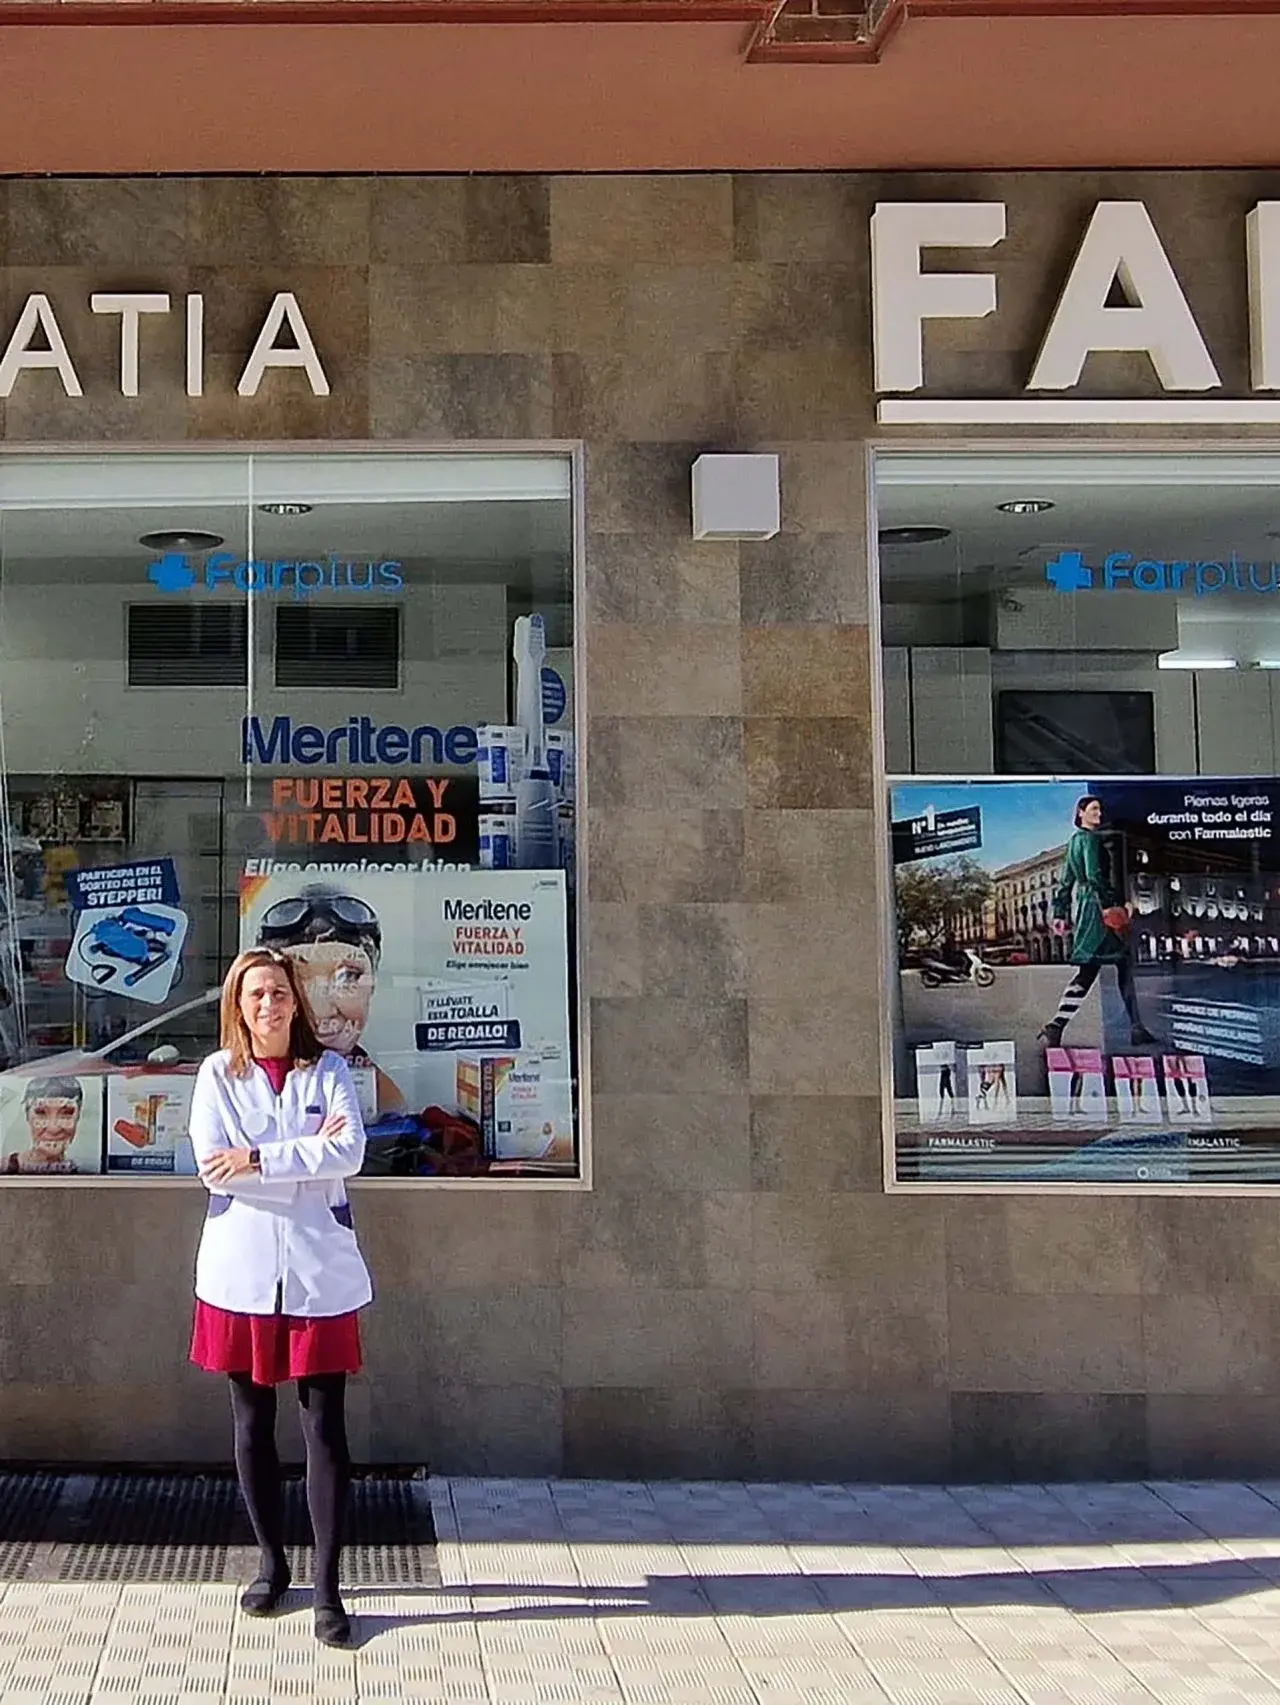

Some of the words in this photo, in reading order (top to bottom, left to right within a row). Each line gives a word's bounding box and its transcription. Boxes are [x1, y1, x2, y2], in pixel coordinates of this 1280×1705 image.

[241, 716, 478, 765] Meritene
[272, 778, 416, 808] FUERZA
[425, 778, 450, 808] Y
[1147, 812, 1199, 825] durante
[1201, 811, 1232, 823] todo
[263, 812, 457, 843] VITALIDAD
[1169, 828, 1192, 840] con
[444, 899, 531, 921] Meritene
[456, 927, 508, 940] FUERZA
[512, 927, 521, 940] Y
[453, 941, 525, 955] VITALIDAD
[450, 1005, 498, 1019] TOALLA
[427, 1027, 447, 1040] DE
[448, 1024, 508, 1039] REGALO!
